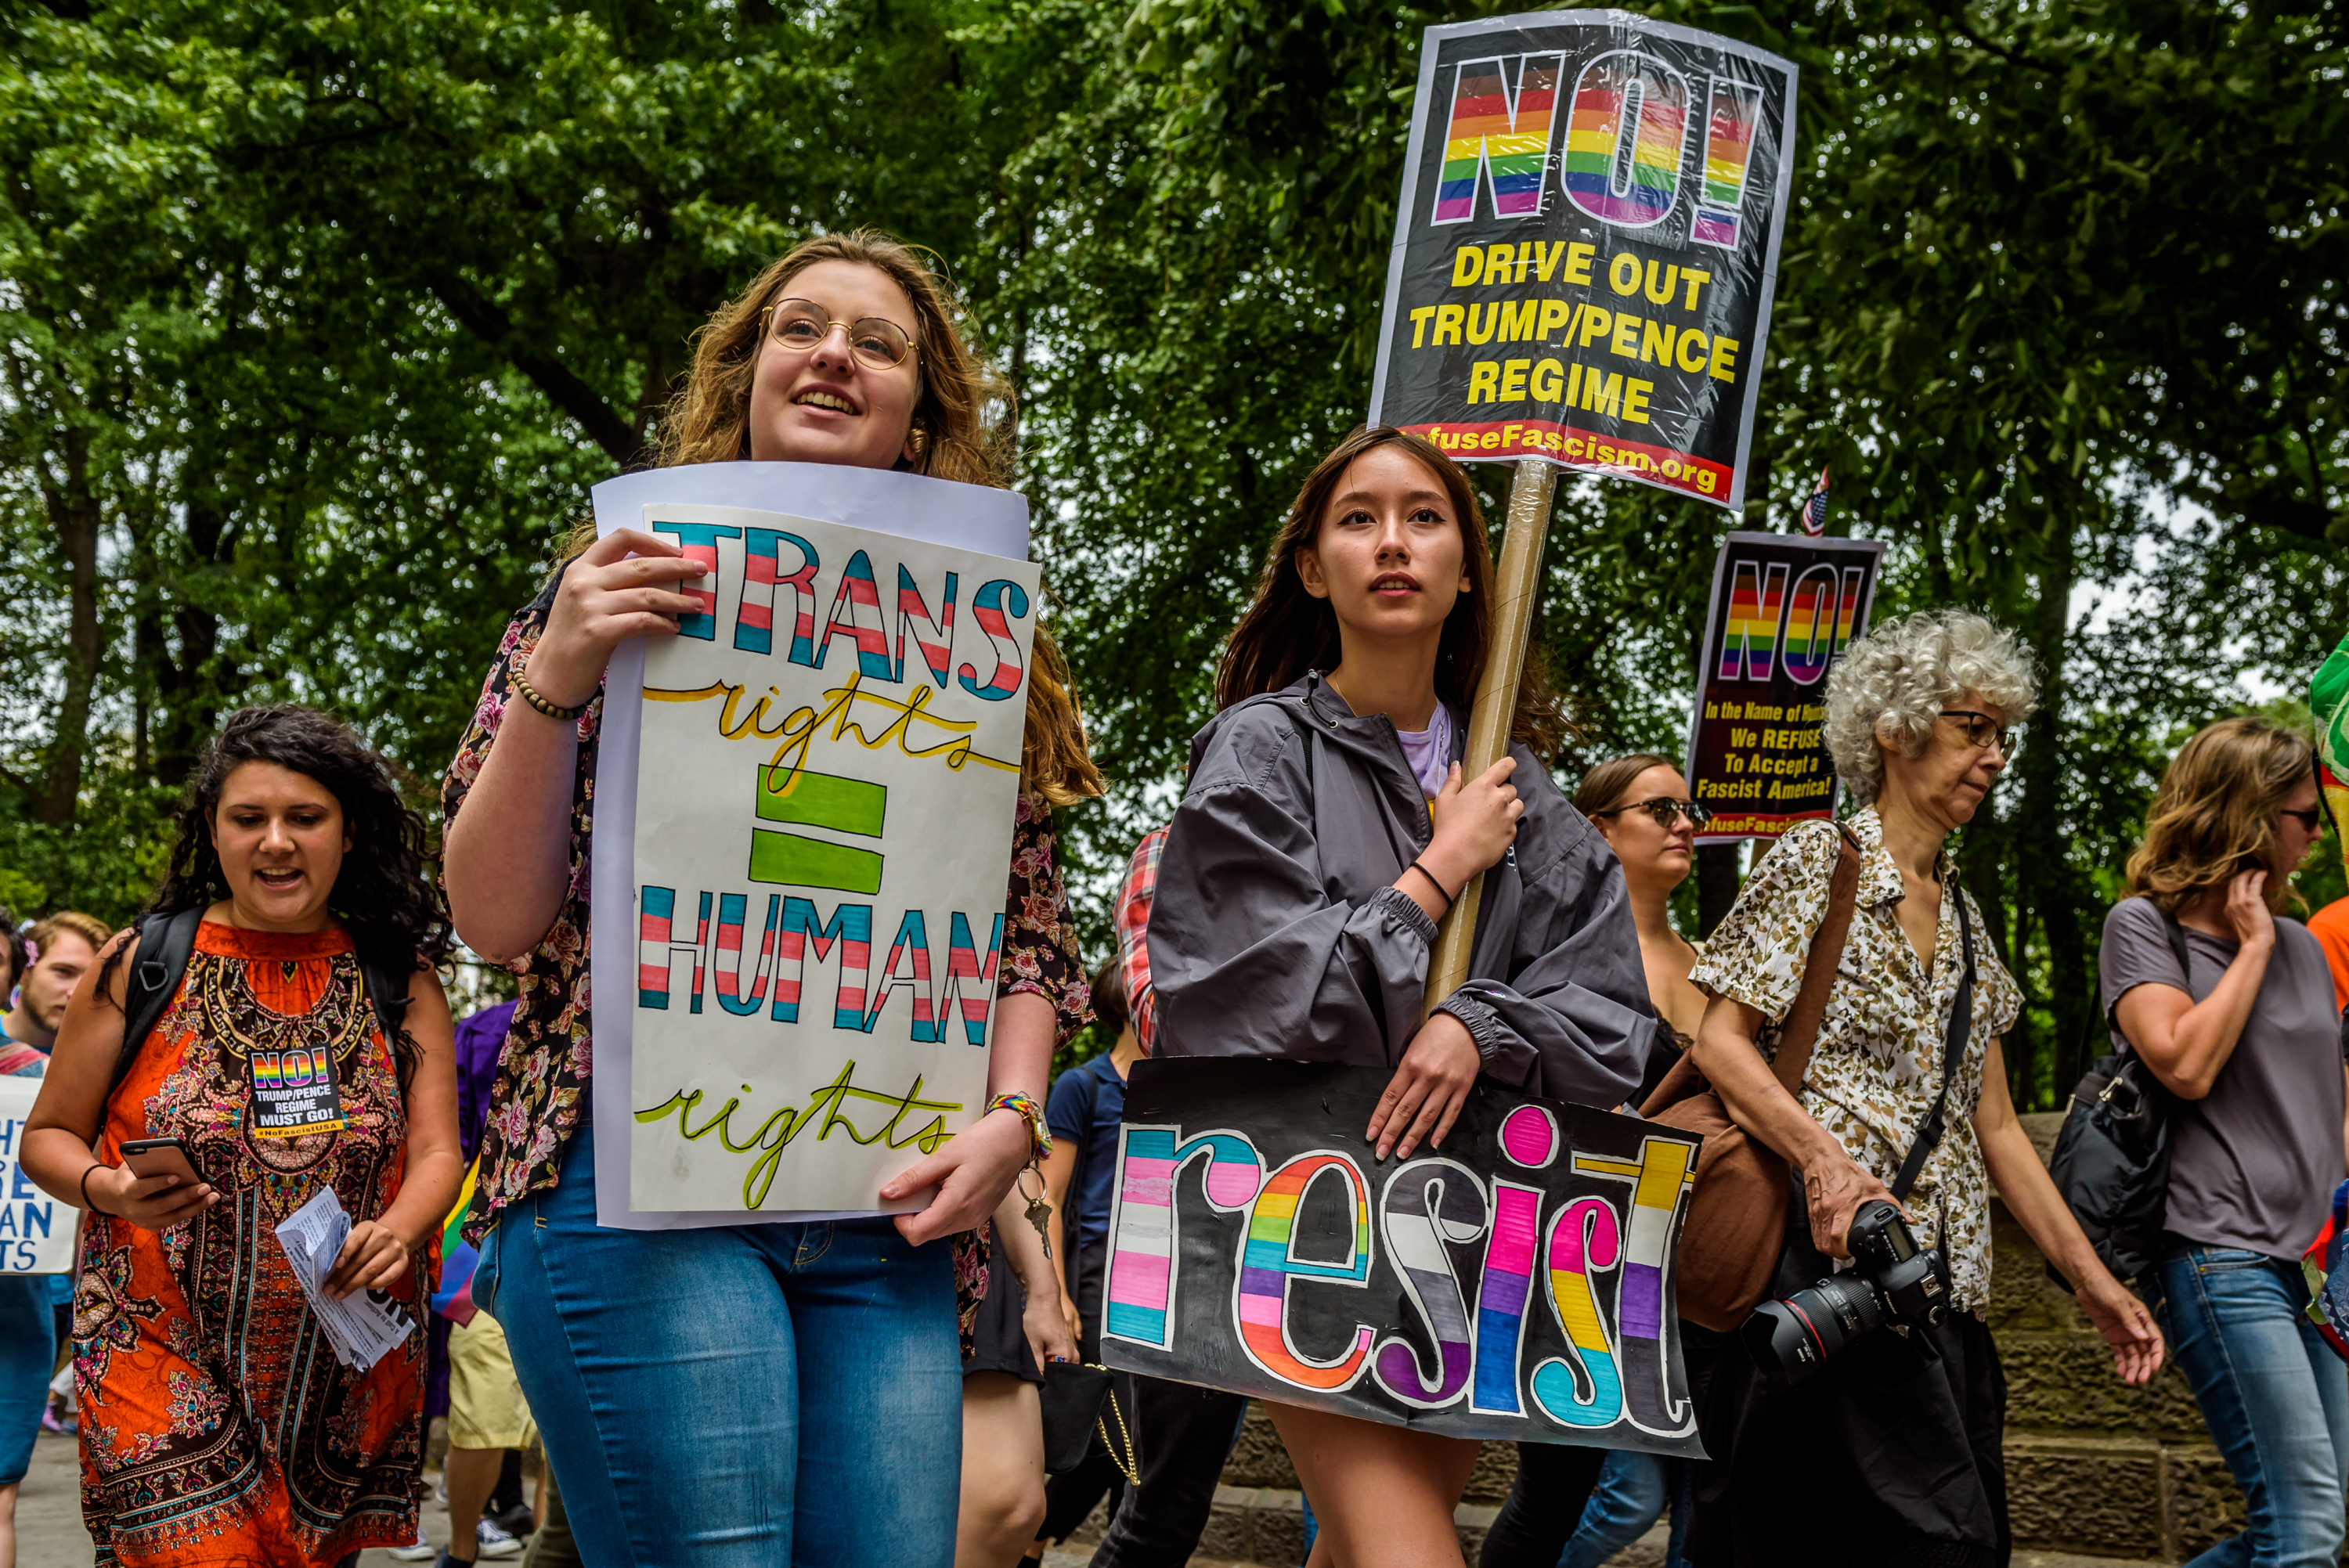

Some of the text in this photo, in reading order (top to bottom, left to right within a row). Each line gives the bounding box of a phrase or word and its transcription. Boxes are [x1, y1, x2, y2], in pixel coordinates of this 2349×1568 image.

[1431, 49, 1764, 251] NO!
[1451, 241, 1710, 311] DRIVE OUT
[1409, 299, 1739, 384] TRUMP/PENCE
[1467, 358, 1654, 425] REGIME
[652, 521, 1029, 701] TRANS
[1718, 560, 1865, 686] NO!
[644, 671, 1021, 797] rights
[1705, 701, 1719, 719] In
[1721, 701, 1742, 719] the
[1745, 701, 1783, 721] Name
[1786, 704, 1802, 722] of
[1725, 753, 1819, 778] To Accept a
[1731, 728, 1820, 750] We REFUSE
[1697, 776, 1831, 799] Fascist America!
[638, 885, 1005, 1046] HUMAN
[251, 1047, 329, 1089] NO!
[255, 1084, 331, 1102] TRUMP/PENCE
[259, 1108, 334, 1126] MUST GO!
[259, 1123, 337, 1137] #NoFascistUSA
[275, 1098, 317, 1114] REGIME
[634, 1059, 963, 1211] rights
[1103, 1102, 1696, 1438] resist
[384, 1320, 396, 1332] Call
